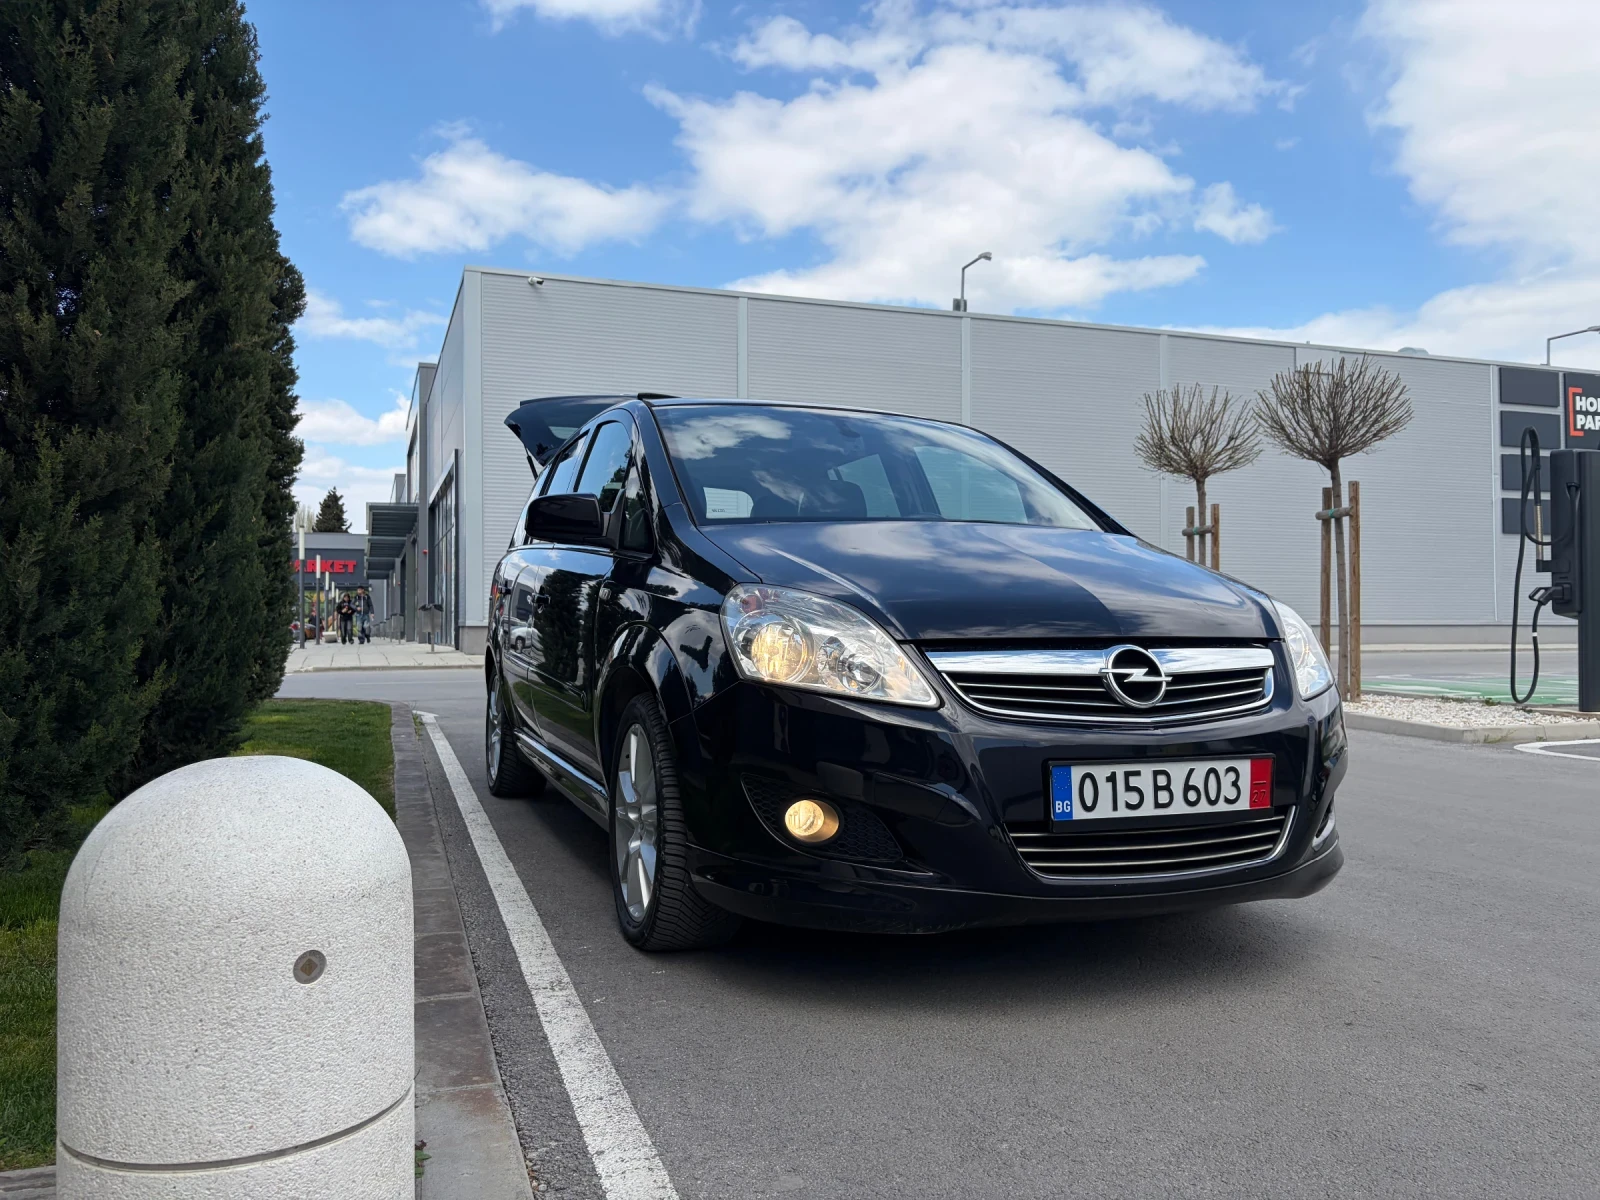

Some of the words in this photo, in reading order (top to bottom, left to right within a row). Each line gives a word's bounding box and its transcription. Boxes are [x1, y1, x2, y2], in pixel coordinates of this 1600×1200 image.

[1575, 395, 1600, 412] HO
[293, 559, 357, 573] ARKET
[1253, 789, 1267, 803] 27
[1055, 800, 1071, 813] BG
